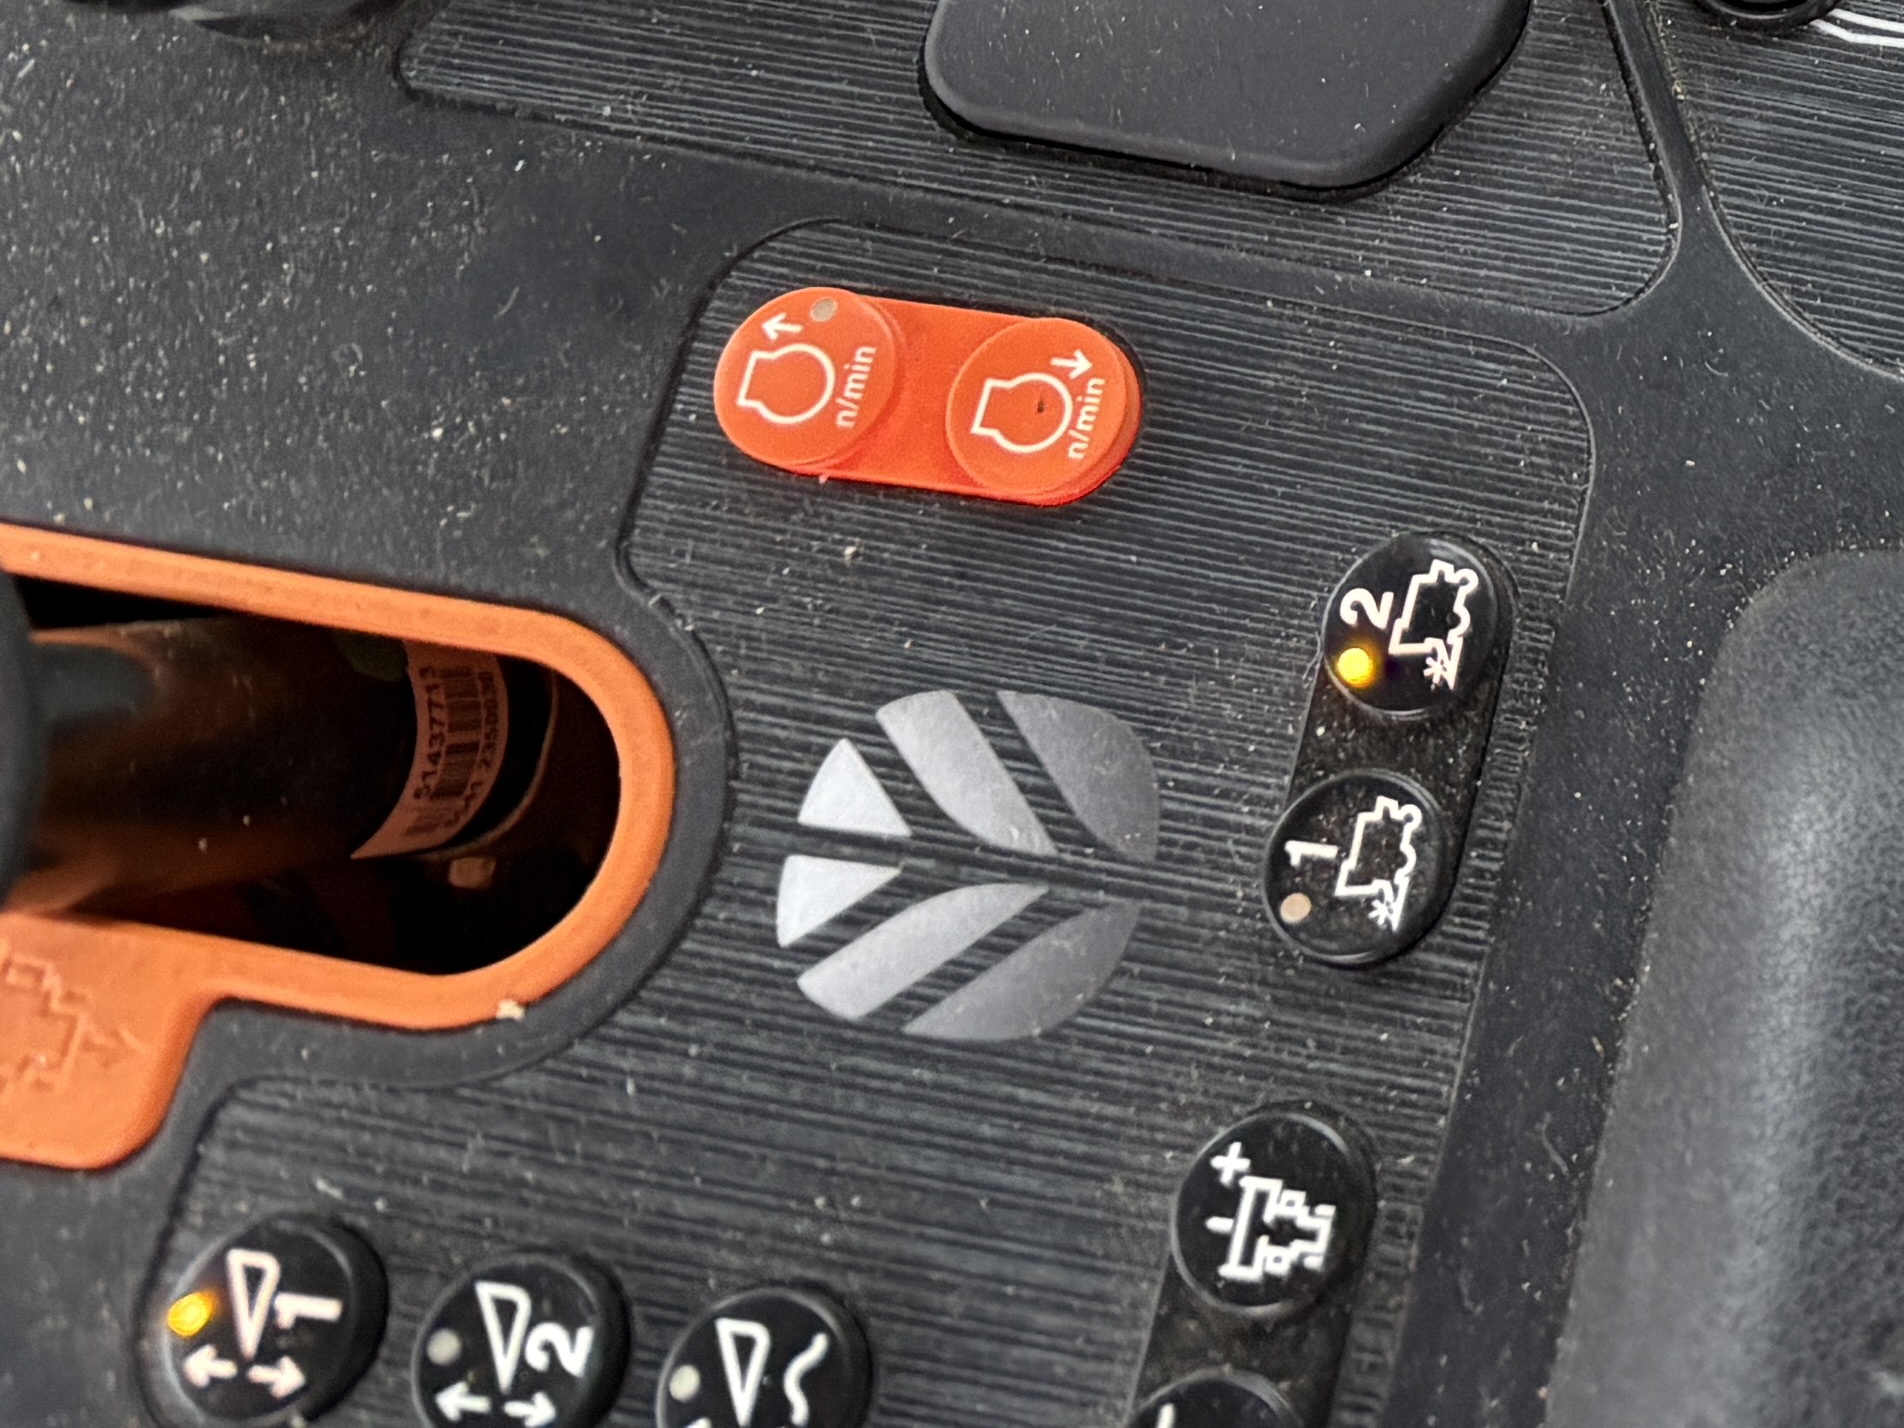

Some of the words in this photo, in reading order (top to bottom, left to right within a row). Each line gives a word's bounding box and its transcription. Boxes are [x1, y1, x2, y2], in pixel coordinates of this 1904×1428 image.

[836, 346, 876, 428] n/min
[1067, 378, 1105, 460] n/min
[1340, 588, 1394, 630] 2
[1284, 841, 1338, 866] 1
[274, 1292, 342, 1329] 1
[526, 1322, 594, 1377] 2
